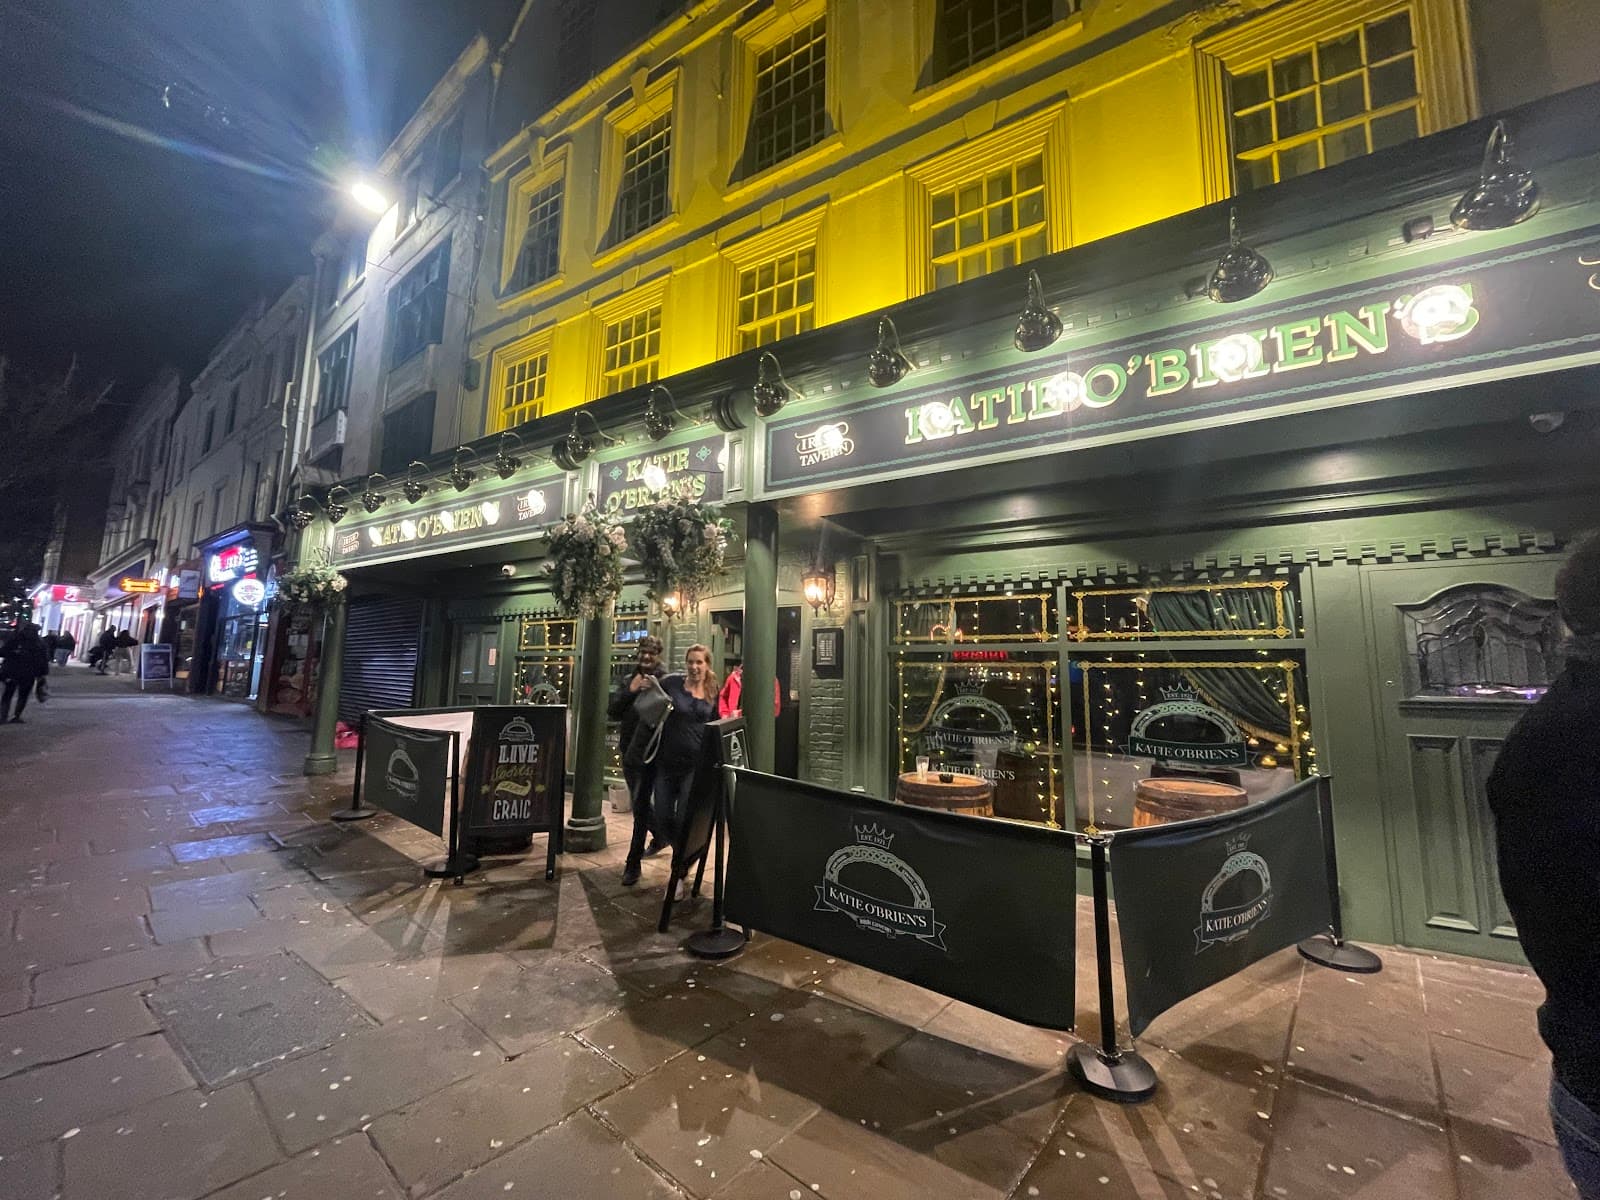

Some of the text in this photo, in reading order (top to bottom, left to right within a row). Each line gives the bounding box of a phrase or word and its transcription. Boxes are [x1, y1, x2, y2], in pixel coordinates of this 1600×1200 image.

[626, 447, 690, 482] KATIE
[606, 474, 706, 512] O'BREN'S
[417, 501, 500, 539] O'BIEN
[935, 730, 963, 745] KATIE
[963, 734, 1011, 746] O'BRIEN'S
[497, 744, 540, 764] LIVE
[1135, 743, 1240, 760] KATIE O'BRIEN'S
[493, 799, 532, 821] CRAIC
[829, 887, 865, 912] KATIE
[865, 902, 928, 928] O'BRIEN'S
[1205, 915, 1233, 932] KATIE
